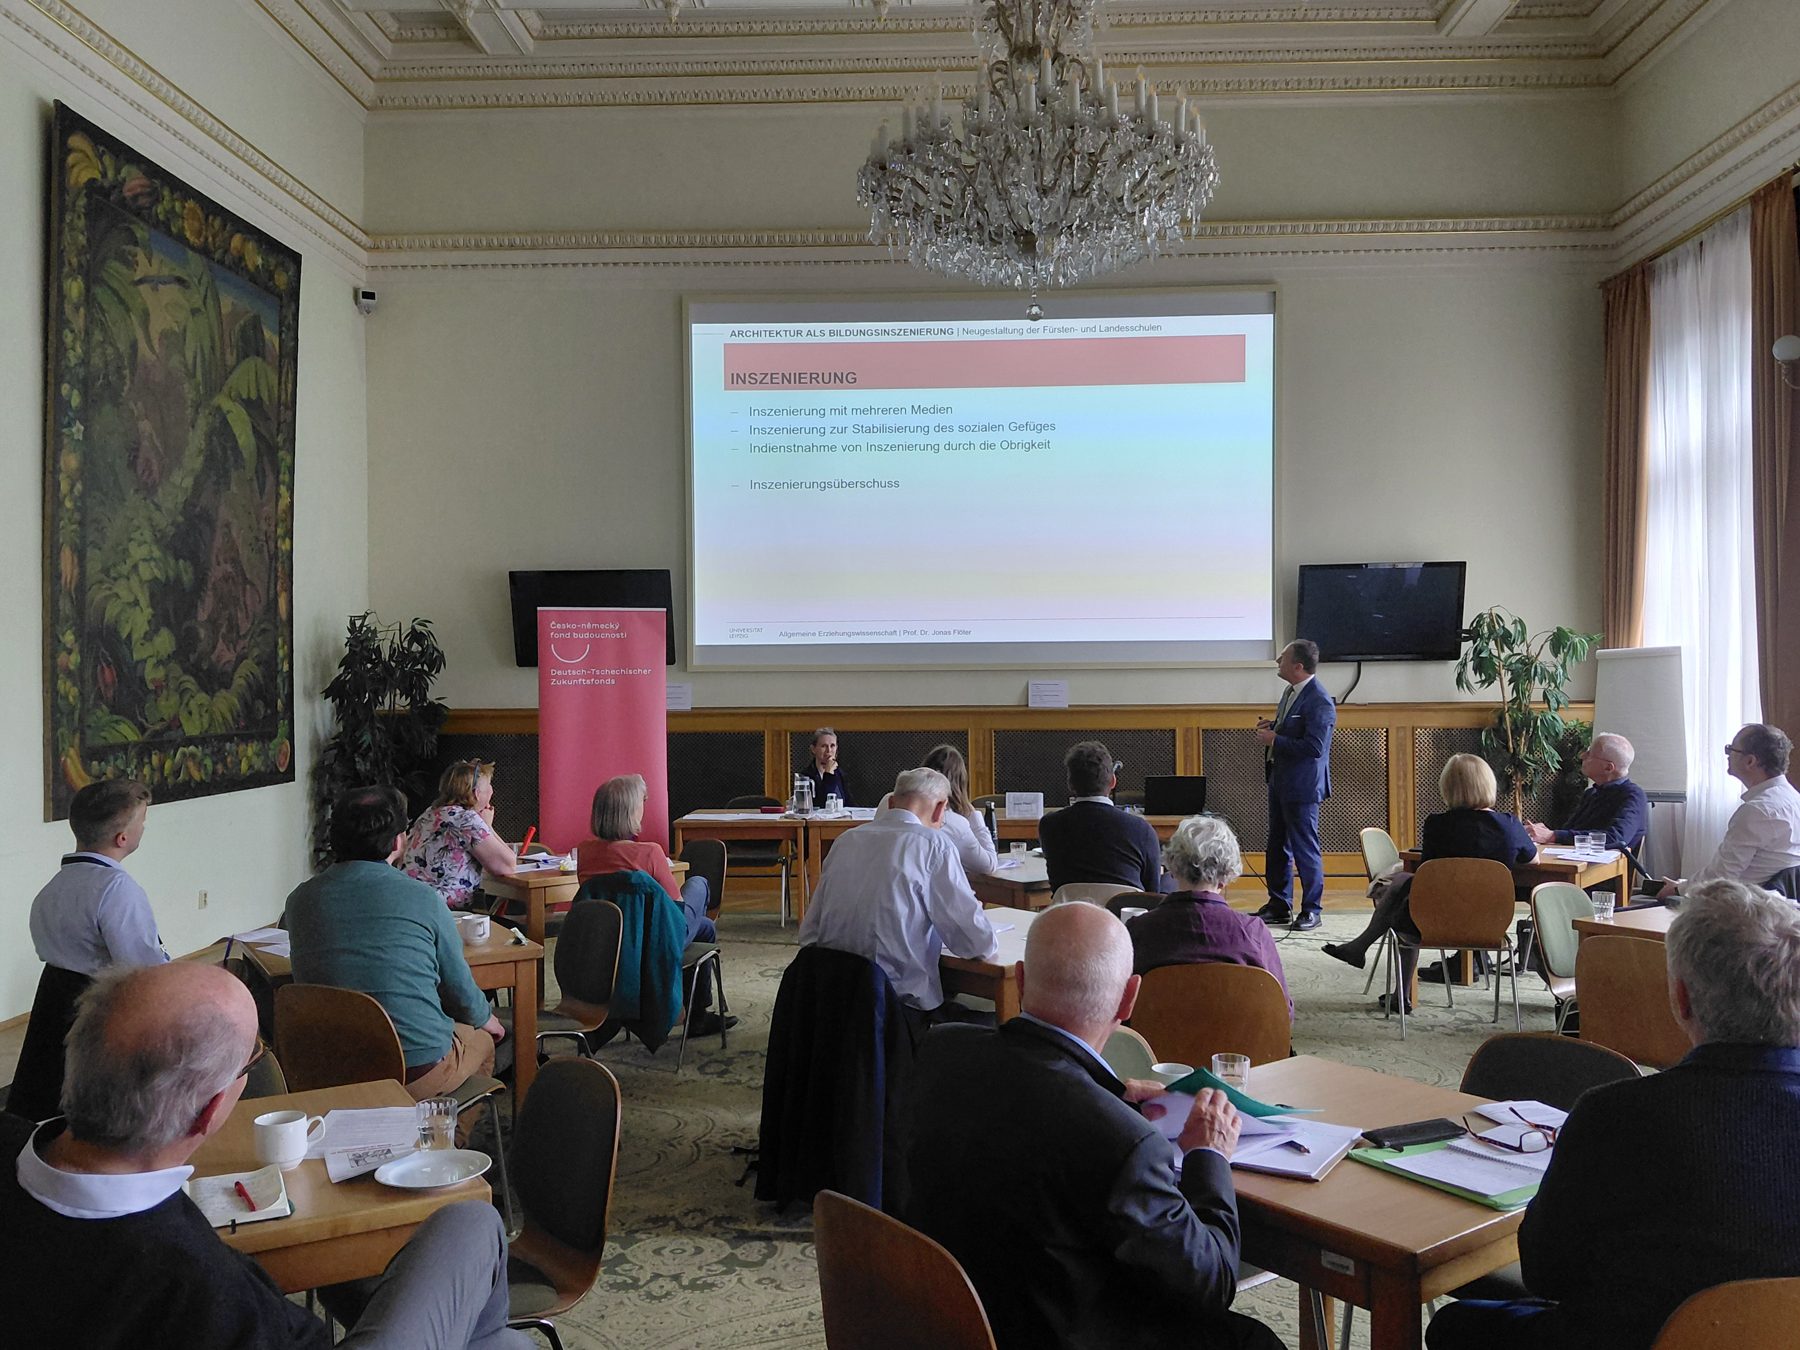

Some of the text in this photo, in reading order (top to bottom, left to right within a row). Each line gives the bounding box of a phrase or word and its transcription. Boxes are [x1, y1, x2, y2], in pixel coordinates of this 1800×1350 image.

[730, 323, 1162, 338] ARCHITEKTUR ALS BILDUNGSINSZENIERUNG Neugestaltung der Fürsten- und Landesschulen
[730, 372, 857, 385] INSZENIERUNG
[749, 404, 953, 418] Inszenierung mit mehreren Medien
[749, 421, 1056, 437] Inszenierung zur Stabilisierung des sozialen Gefüges
[749, 439, 1051, 453] Indienstnahme von Inszenierung durch die Obrigkeit
[750, 479, 900, 491] Inszenierungsüberschuss
[550, 621, 620, 630] Česko-německý
[818, 629, 898, 638] Erziehungswissenschaft
[550, 668, 652, 676] Deutsch-Tschechischer
[550, 678, 616, 686] Zukunftsfonds
